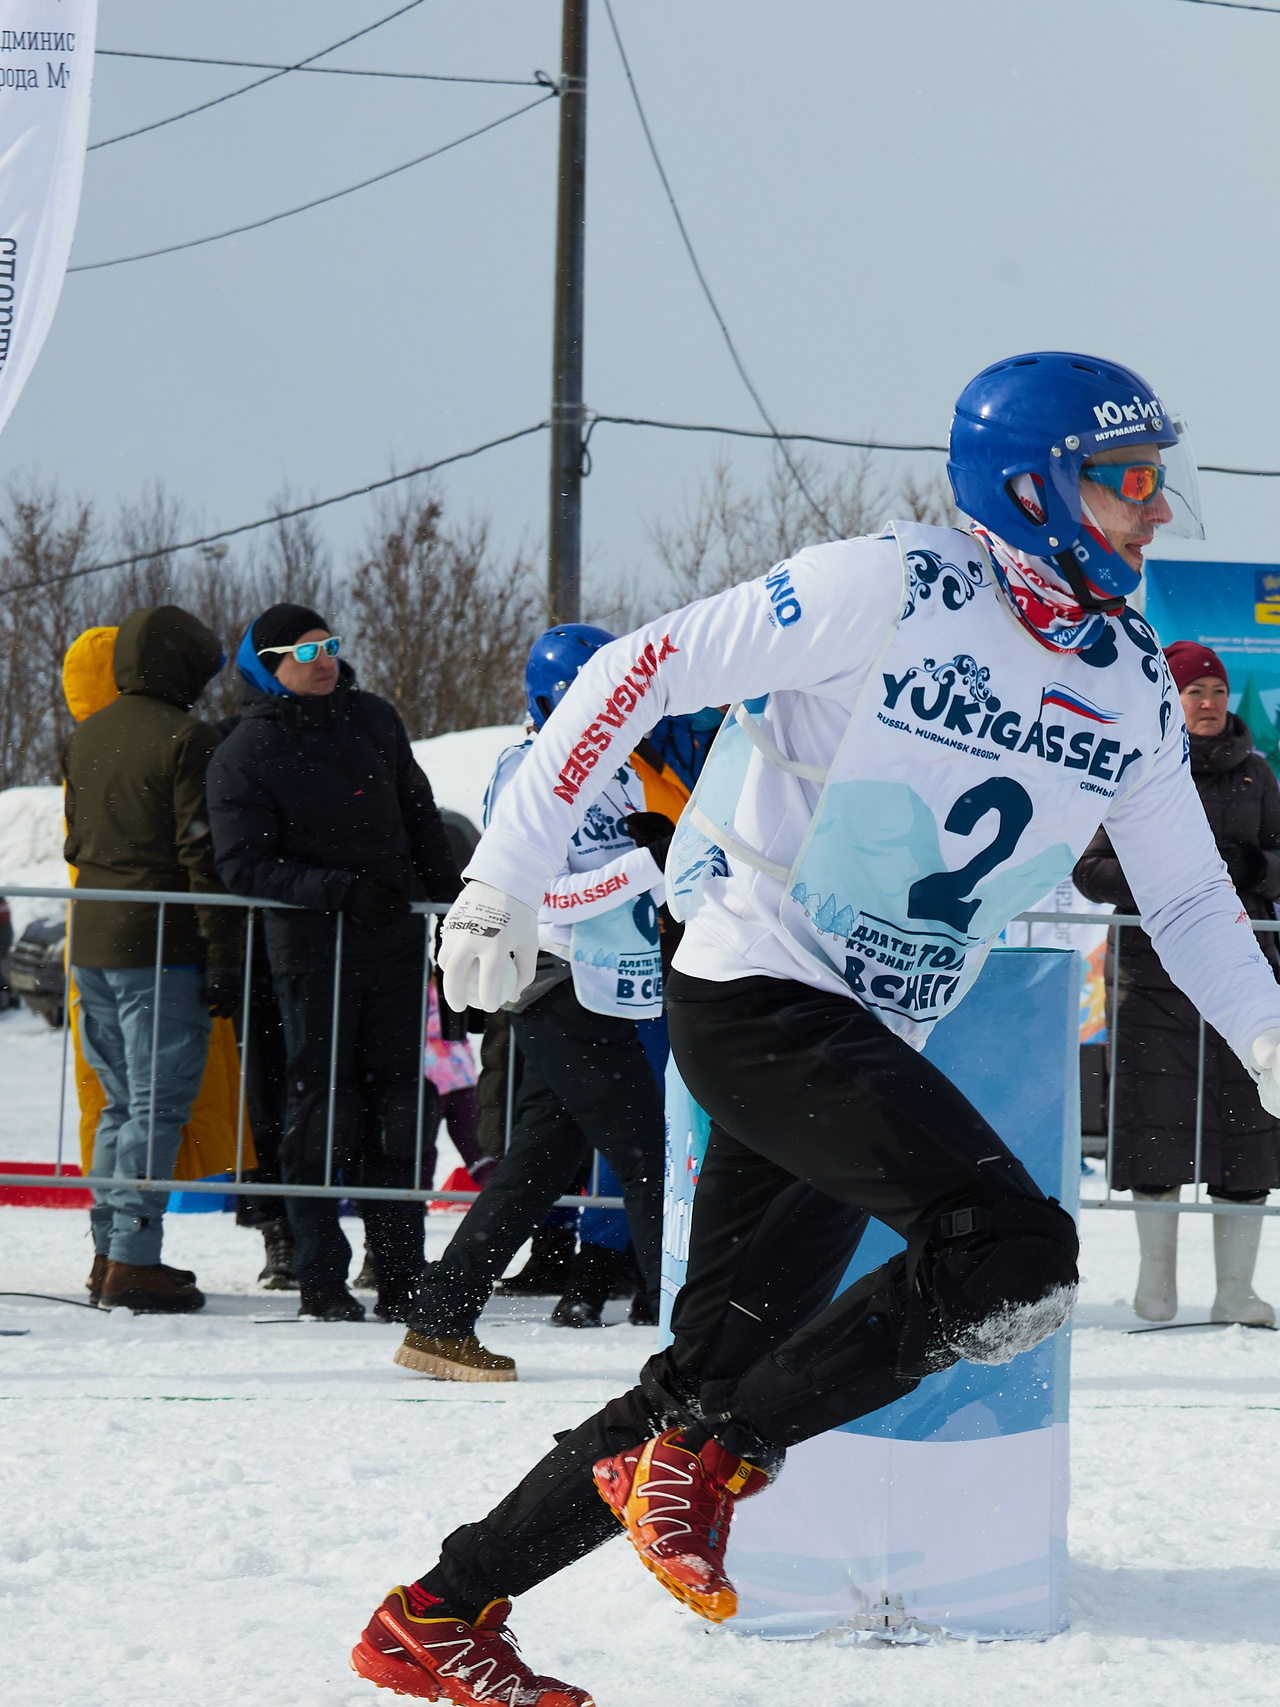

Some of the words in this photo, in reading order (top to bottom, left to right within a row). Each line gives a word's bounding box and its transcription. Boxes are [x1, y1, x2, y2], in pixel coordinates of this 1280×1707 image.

[0, 30, 76, 52] дминис
[1094, 423, 1147, 442] МУРМАНСК
[876, 711, 912, 734] RUSSIA,
[914, 727, 970, 754] MURMANSK
[970, 746, 1001, 762] REGION
[908, 776, 1034, 933] 2
[851, 924, 889, 949] ДЛЯ
[845, 938, 877, 959] КТО
[843, 955, 867, 993] В
[616, 978, 635, 999] В
